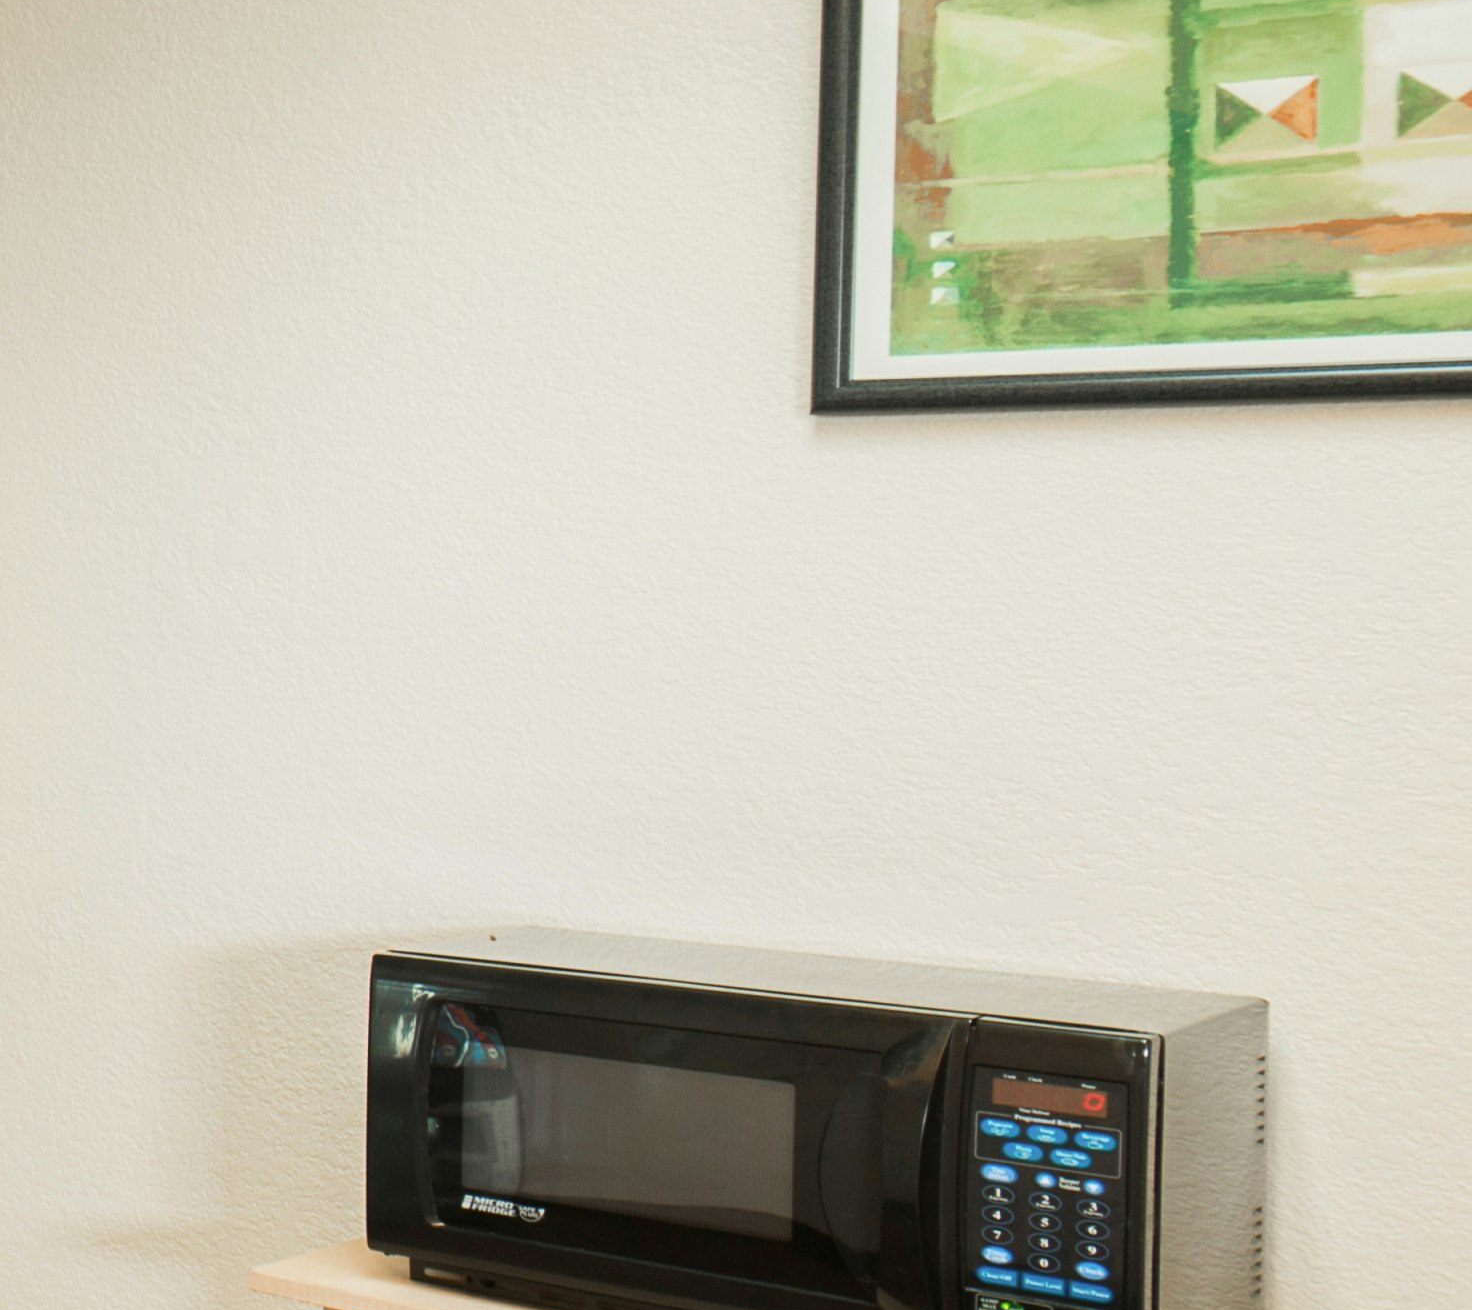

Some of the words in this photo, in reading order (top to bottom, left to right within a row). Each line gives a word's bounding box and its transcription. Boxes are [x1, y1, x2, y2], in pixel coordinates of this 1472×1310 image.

[1082, 1091, 1106, 1112] 0
[472, 1203, 516, 1217] FRIDGE
[474, 1196, 514, 1209] MICRO
[994, 1188, 1001, 1198] 1
[1041, 1194, 1050, 1205] 2
[1089, 1202, 1098, 1212] 3
[992, 1210, 1002, 1220] 4
[1040, 1217, 1050, 1227] 5
[1087, 1225, 1097, 1235] 6
[992, 1229, 1002, 1240] 7
[1040, 1237, 1049, 1248] 8
[1087, 1245, 1097, 1255] 9
[1039, 1258, 1049, 1268] 0
